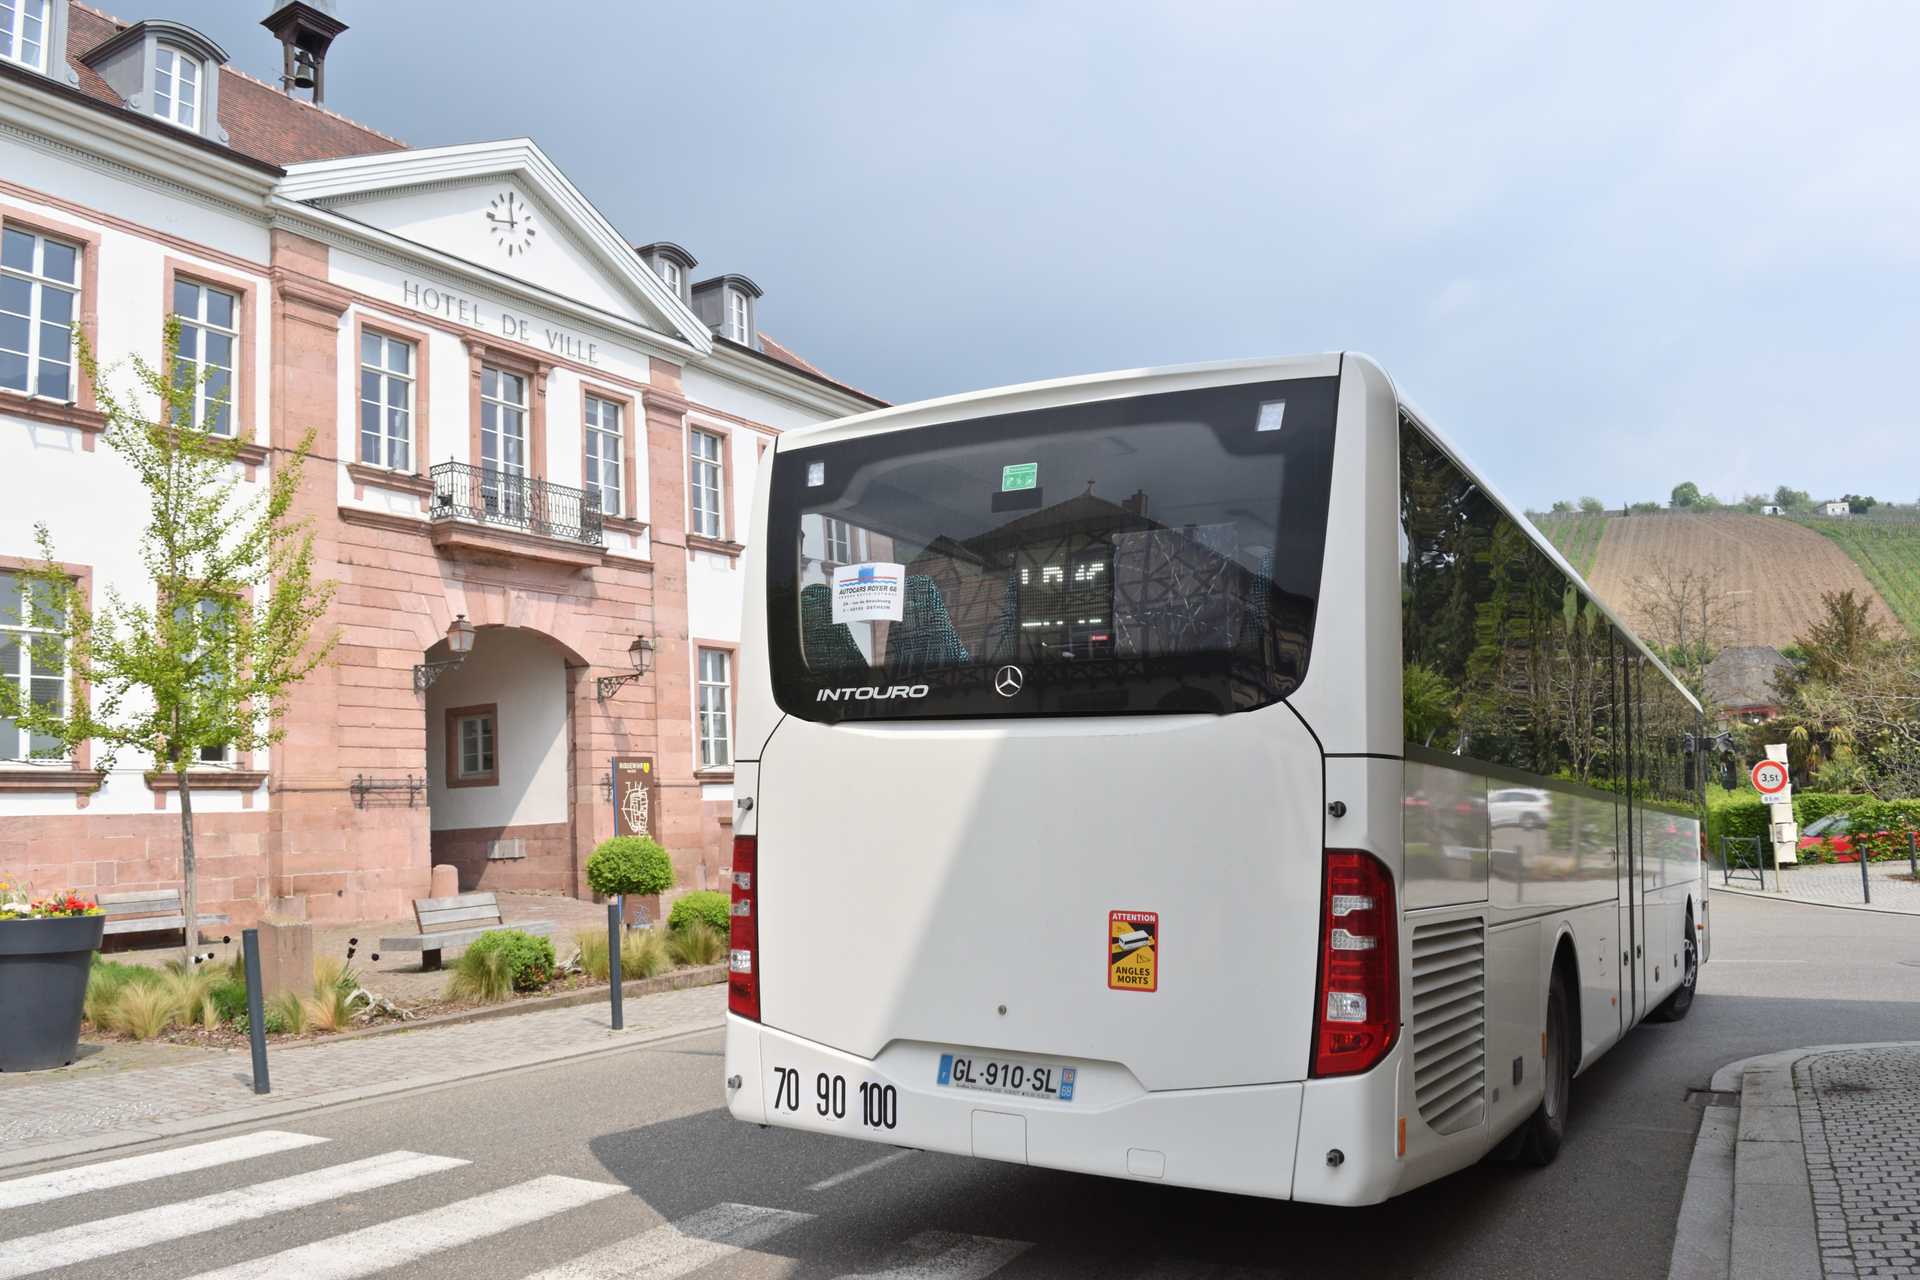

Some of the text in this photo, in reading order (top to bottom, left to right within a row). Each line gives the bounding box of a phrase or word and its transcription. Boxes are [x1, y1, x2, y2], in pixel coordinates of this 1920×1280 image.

[403, 280, 600, 364] HOTEL DE VILLE
[839, 585, 866, 595] AUTOCARS
[816, 684, 929, 702] INTOURO
[1112, 913, 1156, 922] ATTENTION
[1115, 966, 1151, 977] ANGLES
[1117, 976, 1149, 985] MORTS
[773, 1066, 897, 1130] 70 90 100
